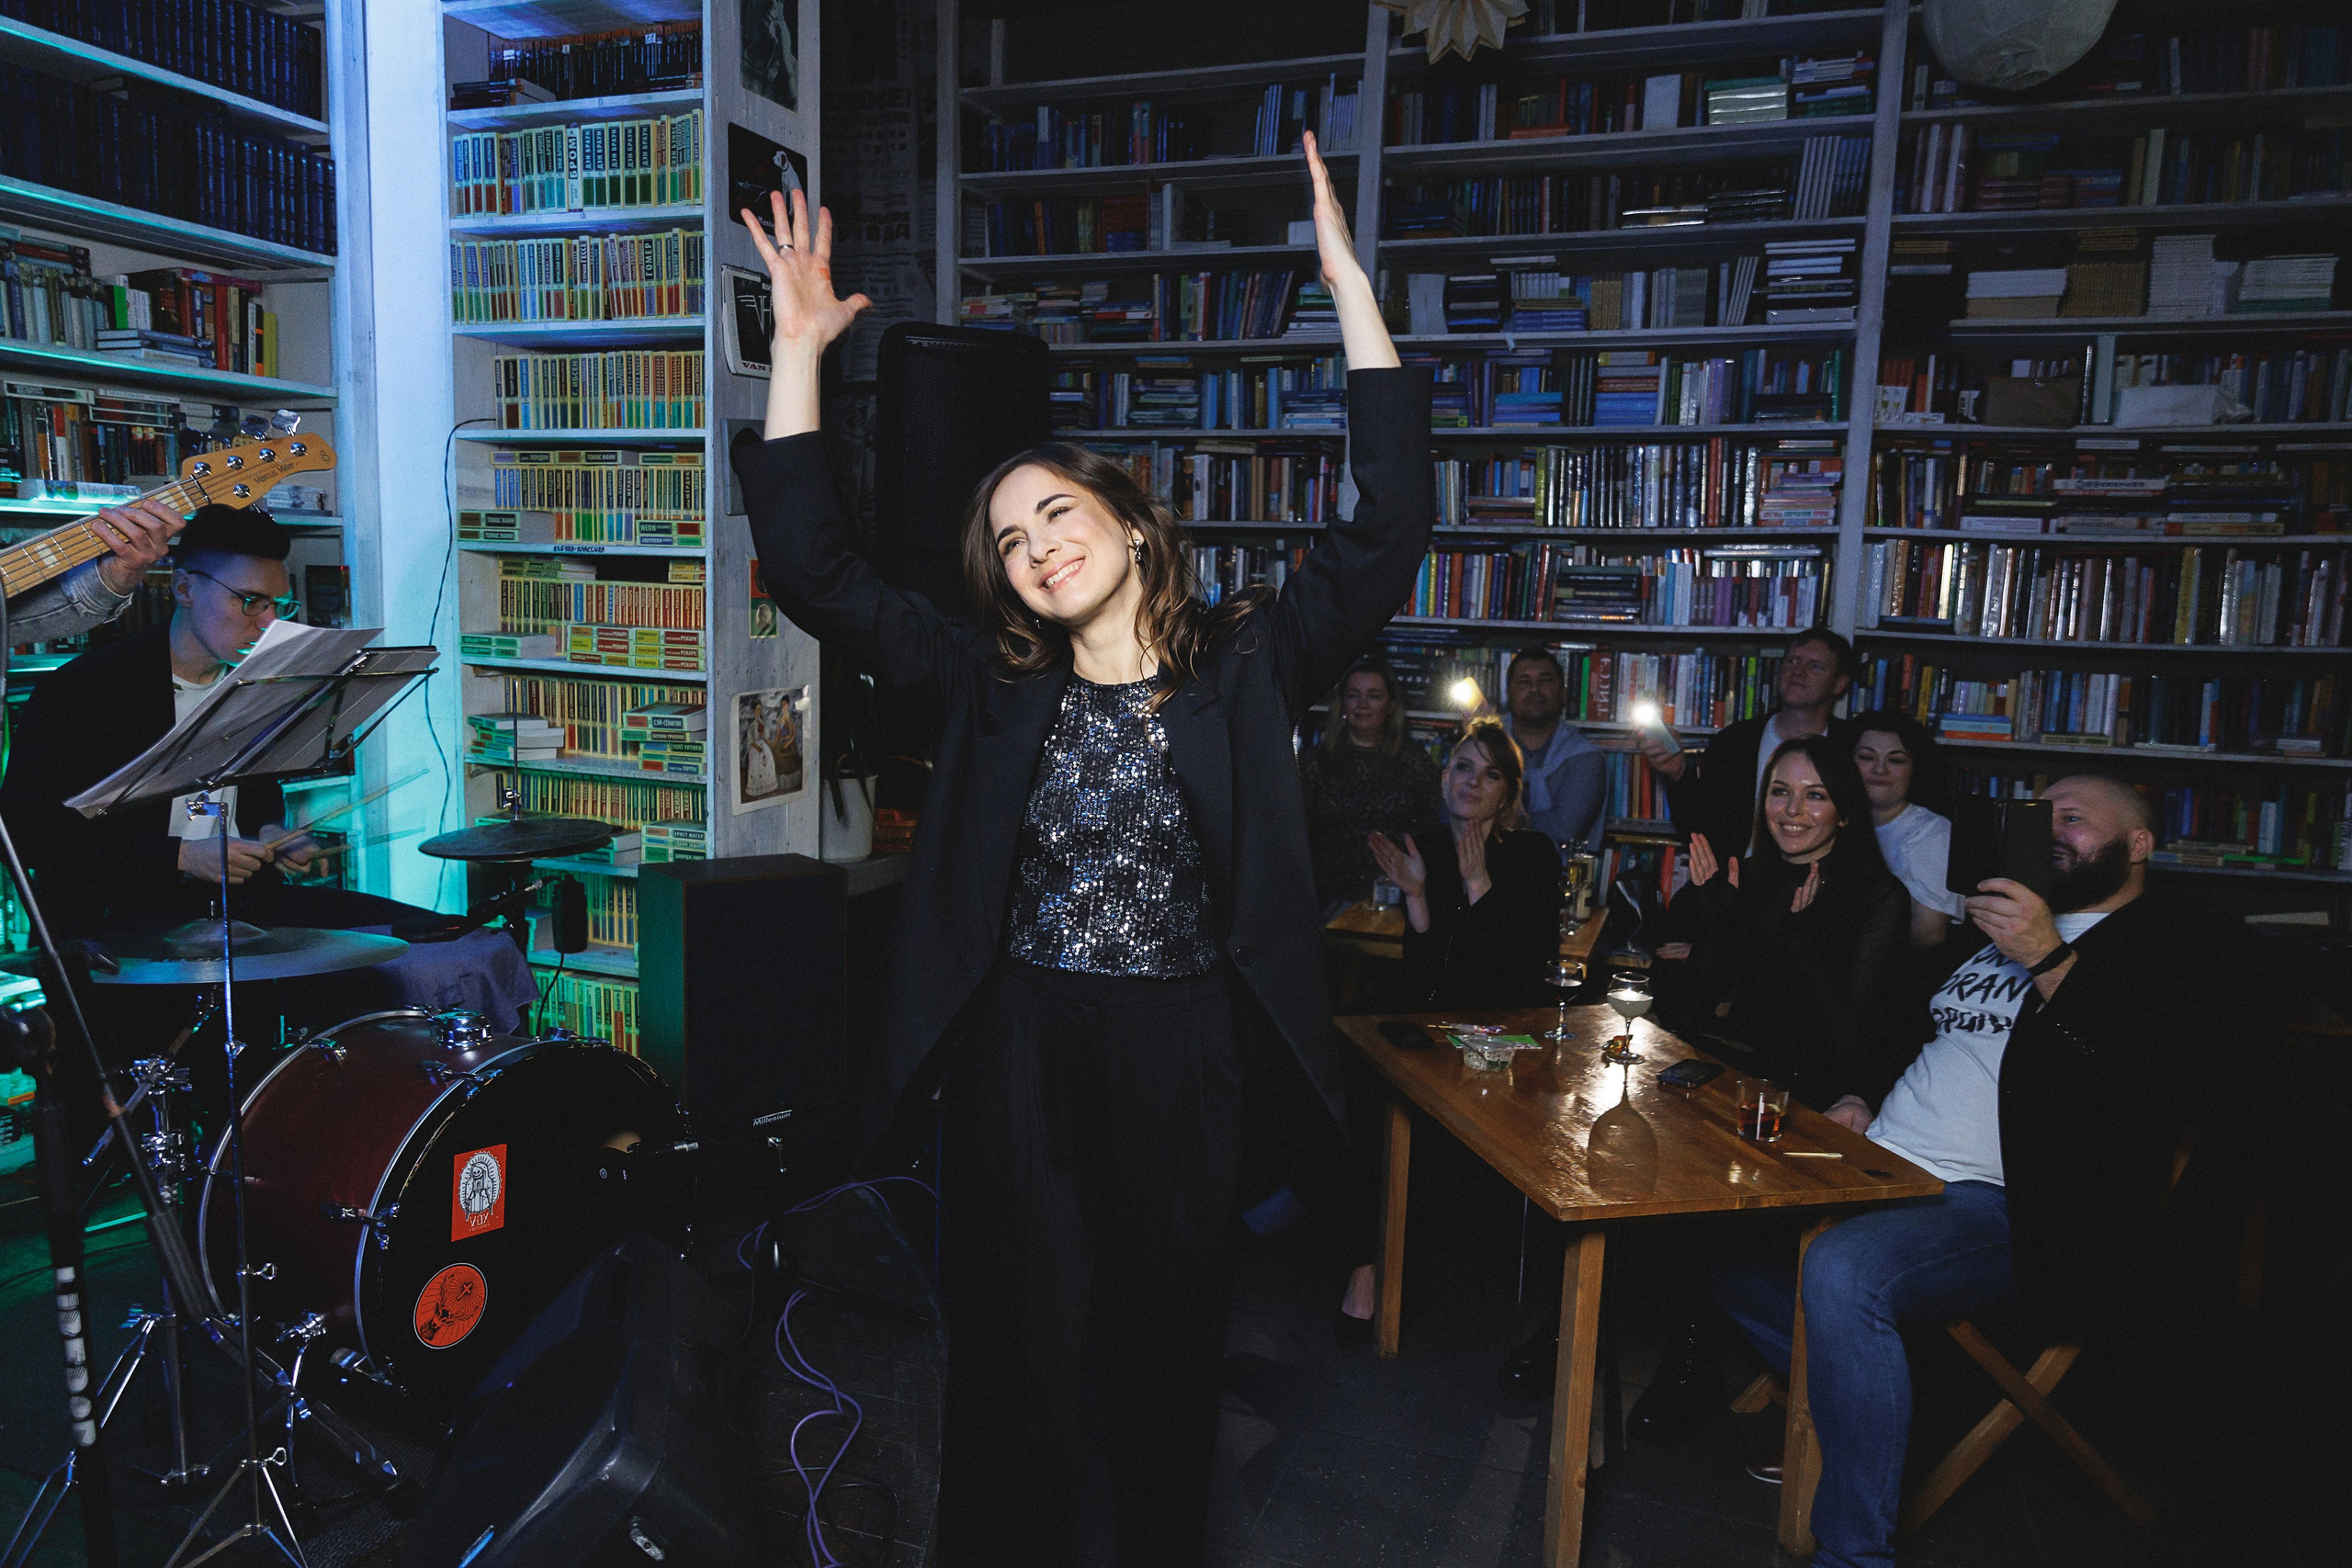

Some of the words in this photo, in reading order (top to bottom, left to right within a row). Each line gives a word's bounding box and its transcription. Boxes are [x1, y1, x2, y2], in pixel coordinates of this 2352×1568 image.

[569, 138, 577, 178] БРОМ
[741, 362, 766, 372] VAN
[752, 1111, 791, 1127] Millenium
